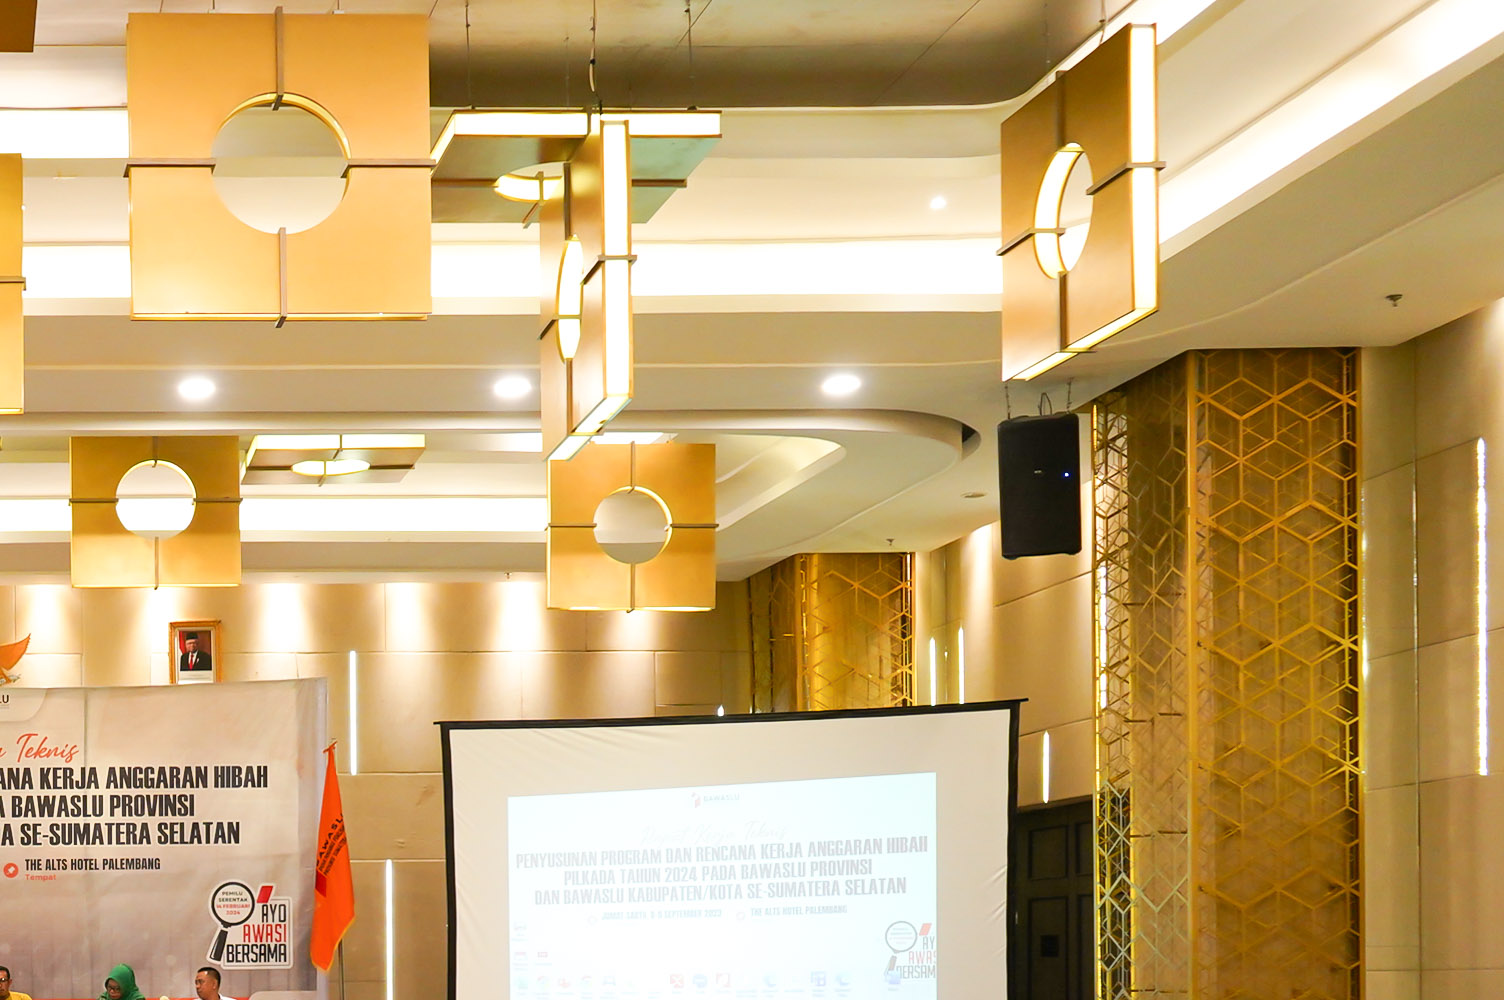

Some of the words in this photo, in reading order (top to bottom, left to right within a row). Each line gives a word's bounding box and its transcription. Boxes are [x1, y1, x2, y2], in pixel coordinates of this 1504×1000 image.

[16, 733, 79, 764] Teknis
[39, 766, 100, 789] KERJA
[105, 765, 208, 789] ANGGARAN
[213, 765, 268, 788] HIBAH
[11, 794, 104, 818] BAWASLU
[109, 794, 195, 817] PROVINSI
[20, 822, 152, 846] SE-SUMATERA
[157, 821, 240, 845] SELATAN
[516, 852, 597, 869] PENYUSUNAN
[600, 849, 662, 866] PROGRAM
[665, 847, 692, 864] DAN
[696, 844, 756, 863] RENCANA
[760, 842, 803, 860] KERJA
[807, 838, 882, 857] ANGGARAN
[886, 835, 928, 854] HIBAH
[25, 859, 44, 871] THE
[45, 859, 68, 871] ALTS
[70, 858, 100, 871] HOTEL
[102, 858, 161, 871] PALEMBANG
[563, 870, 615, 886] PILKADA
[619, 867, 661, 884] TAHUN
[664, 866, 697, 883] 2024
[701, 864, 736, 881] PADA
[740, 861, 806, 880] BAWASLU
[810, 858, 872, 878] PROVINSI
[25, 874, 57, 882] Tempat
[534, 889, 560, 905] DAN
[563, 887, 625, 905] BAWASLU
[628, 883, 743, 904] KABUPATEN/KOTA
[747, 879, 841, 899] SE-SUMATERA
[844, 876, 907, 896] SELATAN
[261, 903, 287, 923] AYO
[243, 924, 287, 943] AWASI
[226, 943, 287, 963] BERSAMA
